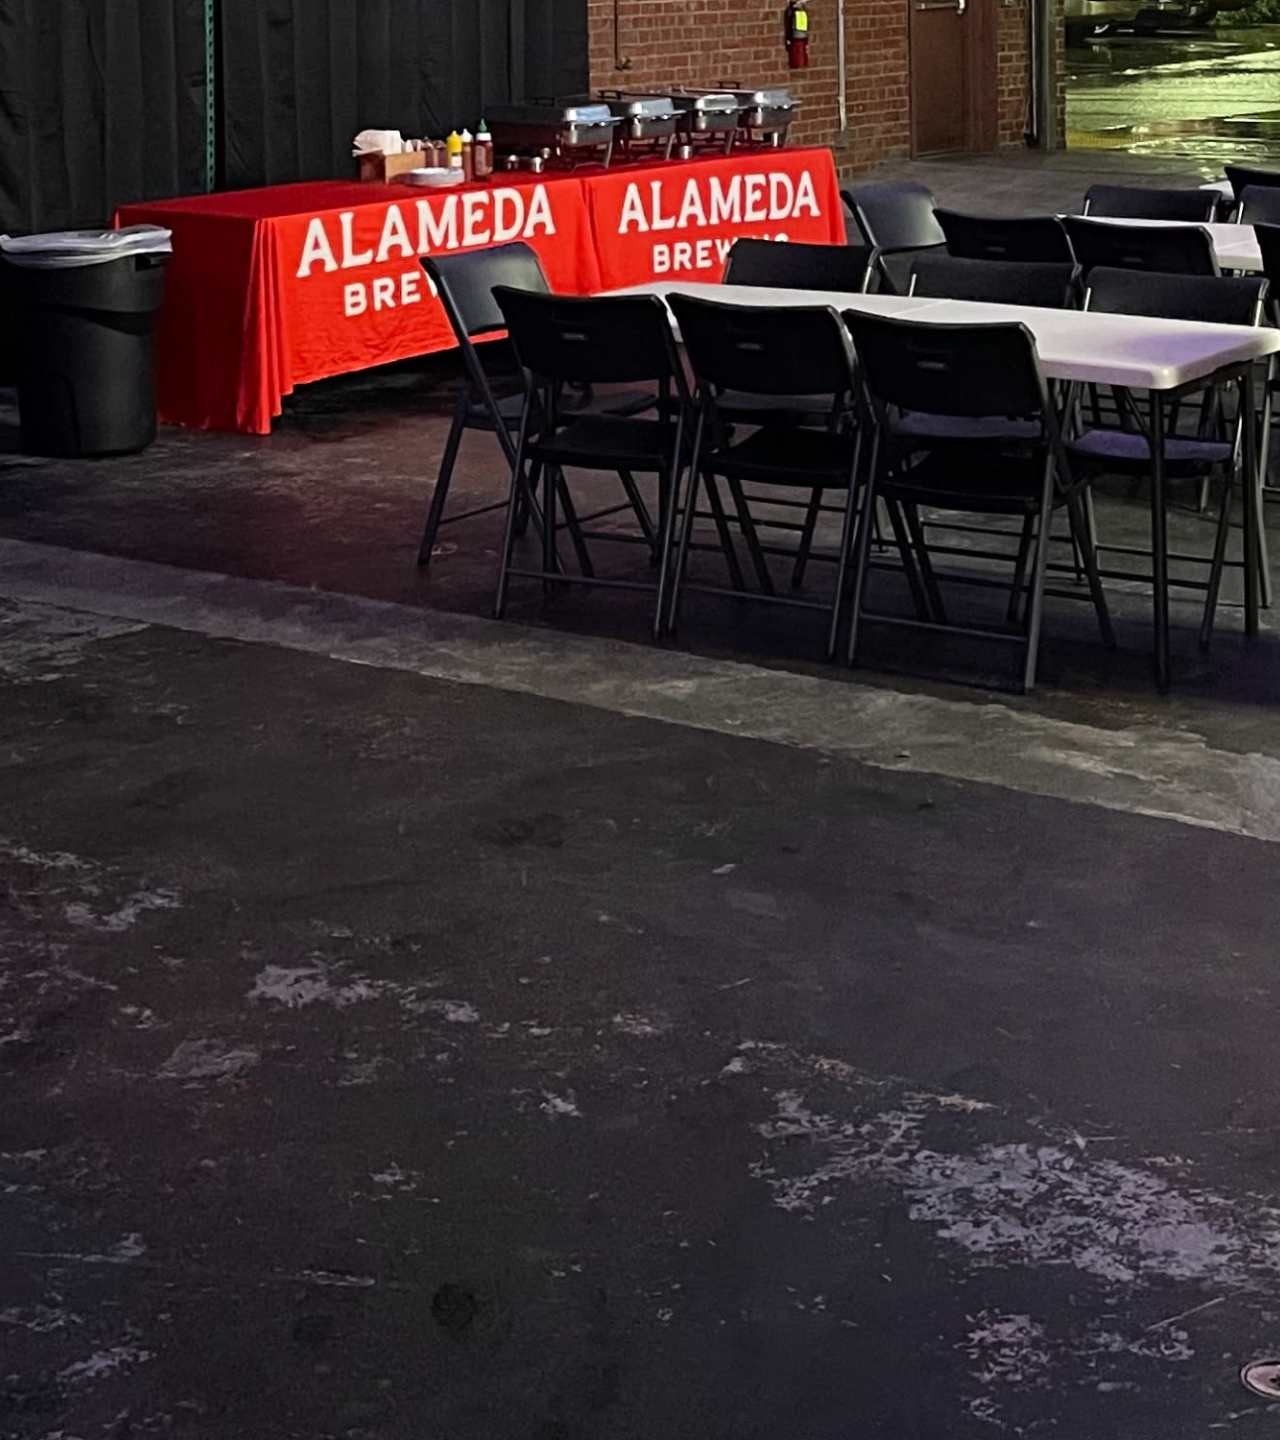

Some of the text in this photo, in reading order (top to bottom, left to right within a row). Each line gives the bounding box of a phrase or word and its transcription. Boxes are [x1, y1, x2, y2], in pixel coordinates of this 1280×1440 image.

[617, 171, 820, 235] ALAMEDA
[296, 184, 556, 278] ALAMEDA
[652, 232, 789, 274] BREW
[344, 271, 438, 317] BRE
